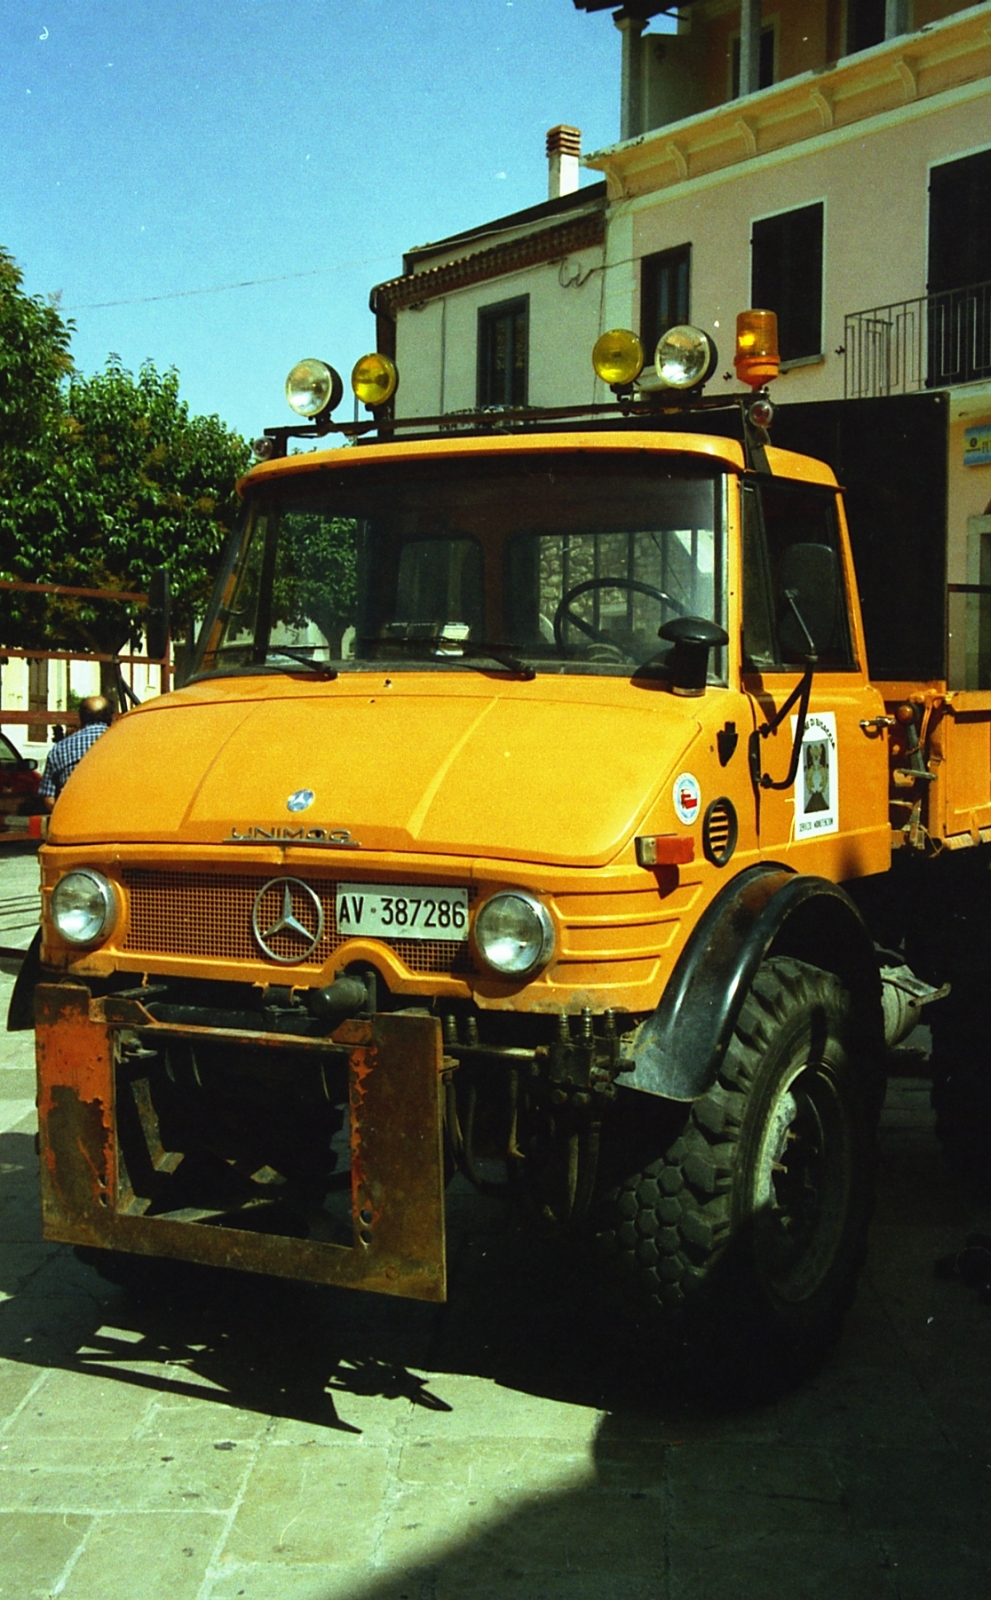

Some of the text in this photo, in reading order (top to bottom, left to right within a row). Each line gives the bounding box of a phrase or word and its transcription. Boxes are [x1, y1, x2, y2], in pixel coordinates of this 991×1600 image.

[231, 826, 351, 842] UNIMOG
[339, 895, 466, 928] AV 387286
